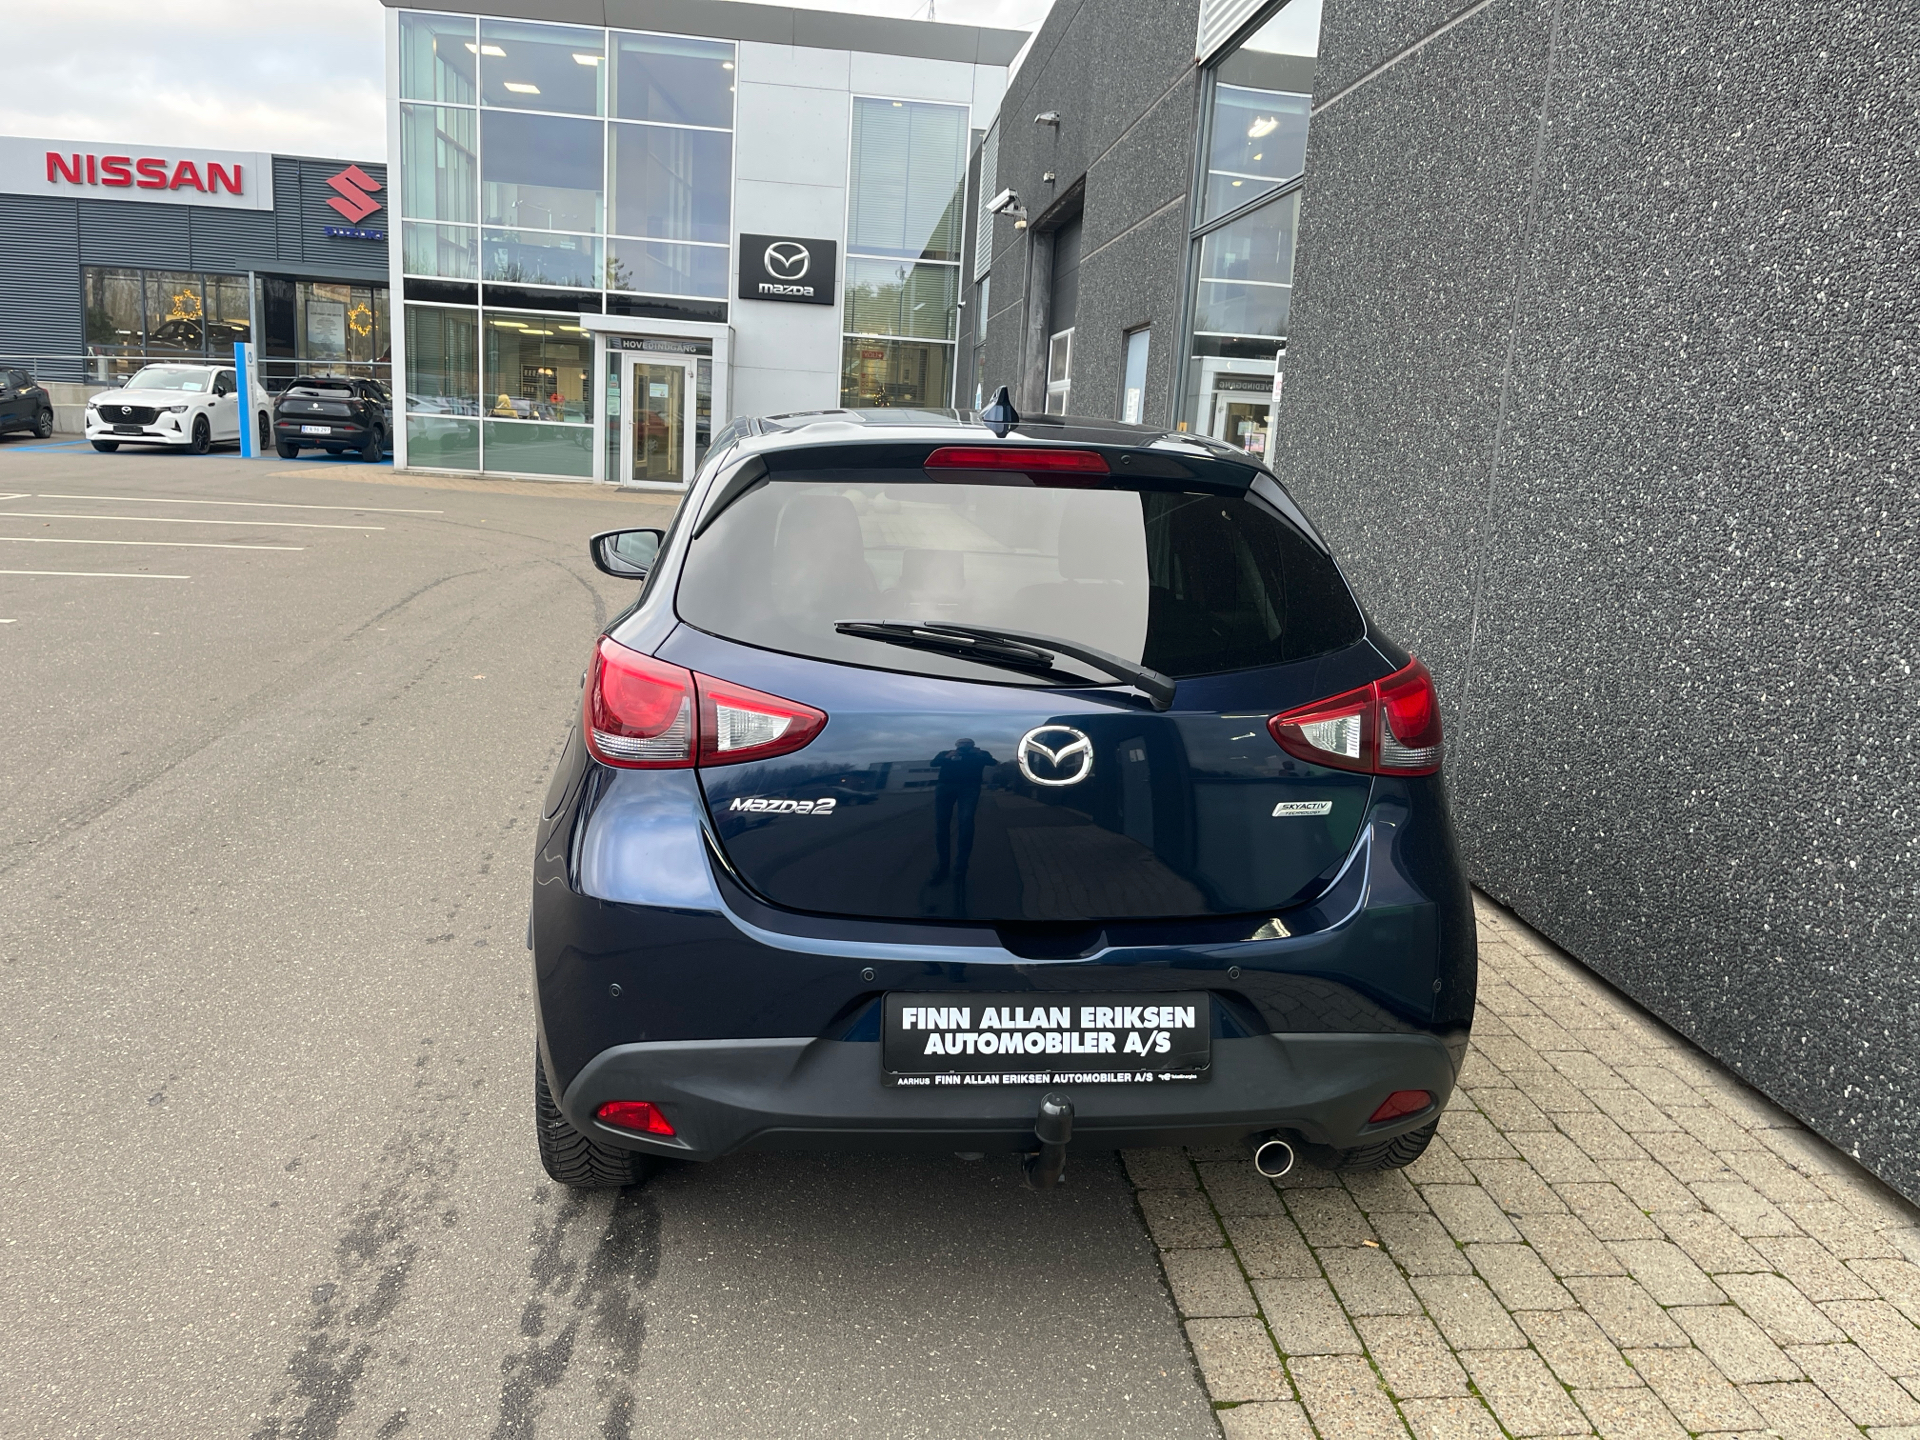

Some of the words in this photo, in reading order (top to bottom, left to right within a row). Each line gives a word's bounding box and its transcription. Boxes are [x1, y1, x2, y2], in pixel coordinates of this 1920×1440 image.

[46, 151, 244, 195] NISSAN
[324, 226, 383, 240] SUZUKI
[758, 282, 814, 297] mazda
[622, 340, 697, 353] HOVEDINDGANG
[1281, 802, 1328, 810] SKYACTIV
[902, 1007, 971, 1030] FINN
[979, 1007, 1071, 1029] ALLAN
[1080, 1006, 1196, 1029] ERIKSEN
[923, 1031, 1117, 1055] AUTOMOBILER
[1123, 1030, 1172, 1057] A/S
[897, 1077, 930, 1085] AARHUS
[935, 1075, 961, 1085] FINN
[963, 1074, 1000, 1085] ALLAN
[1002, 1074, 1050, 1084] ERIKSEN
[1053, 1073, 1132, 1084] AUTOMOBILER
[1134, 1072, 1154, 1082] A/S
